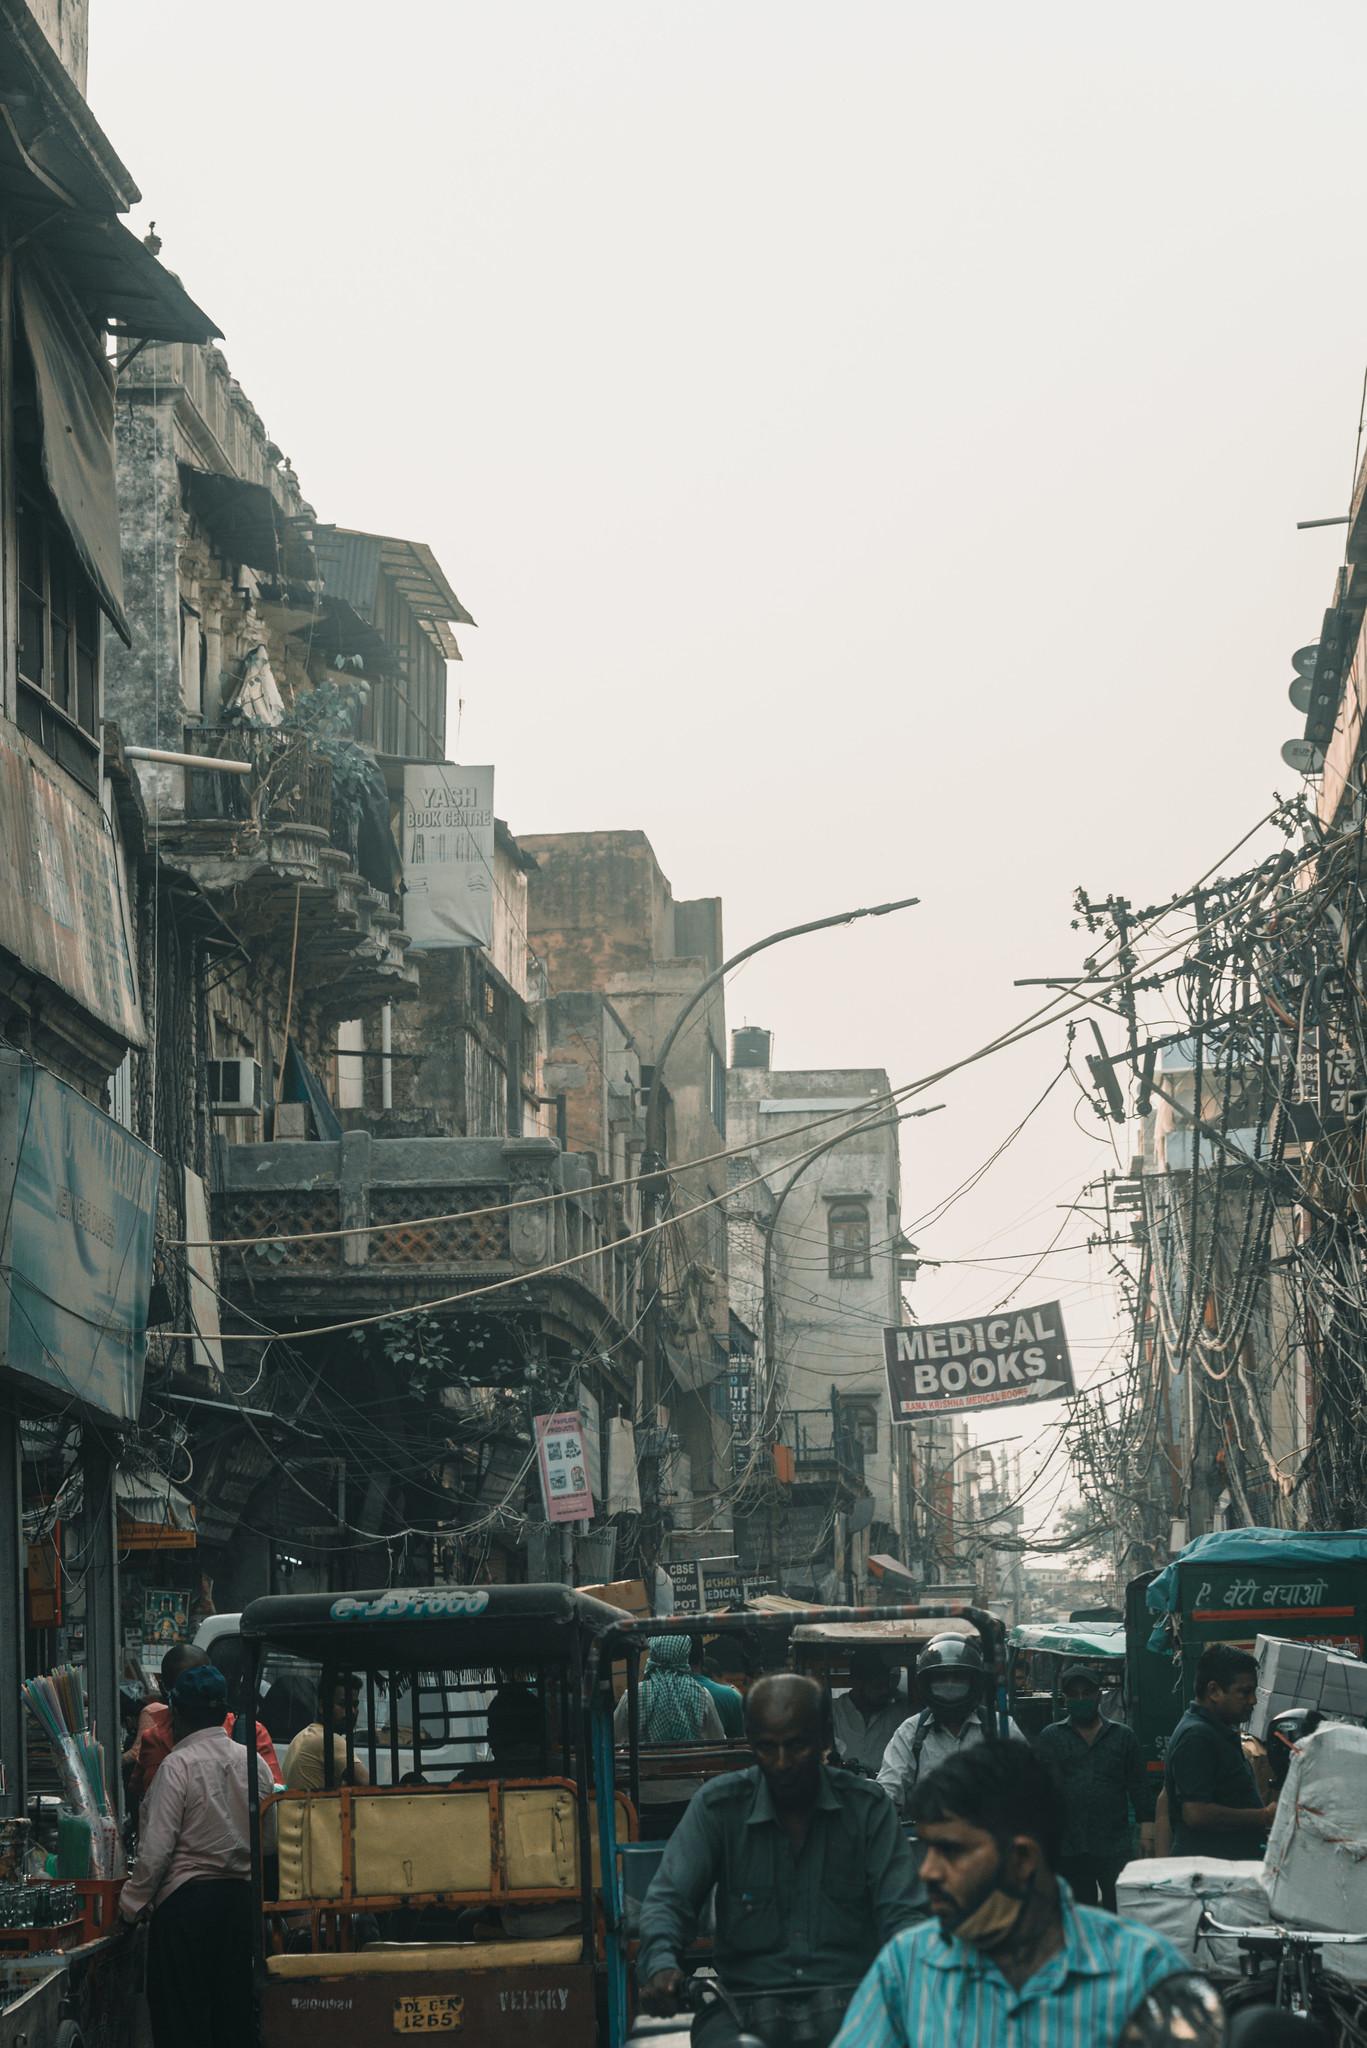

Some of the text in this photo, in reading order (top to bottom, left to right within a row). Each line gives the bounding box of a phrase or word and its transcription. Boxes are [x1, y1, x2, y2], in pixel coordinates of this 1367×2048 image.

[420, 787, 477, 808] YASH
[407, 809, 491, 829] BOOK CENTRE
[896, 1312, 1056, 1361] MEDICAL
[914, 1347, 1047, 1394] BOOKS
[929, 1397, 966, 1410] KRISHNA
[966, 1394, 1001, 1406] MEDICAL
[669, 1563, 695, 1576] CBSE
[671, 1577, 687, 1585] NOU
[676, 1584, 697, 1592] BOOK
[1223, 1577, 1329, 1607] बेटी बचाओ
[674, 1599, 697, 1609] POT
[404, 2001, 421, 2013] DL
[403, 2012, 452, 2028] 1265
